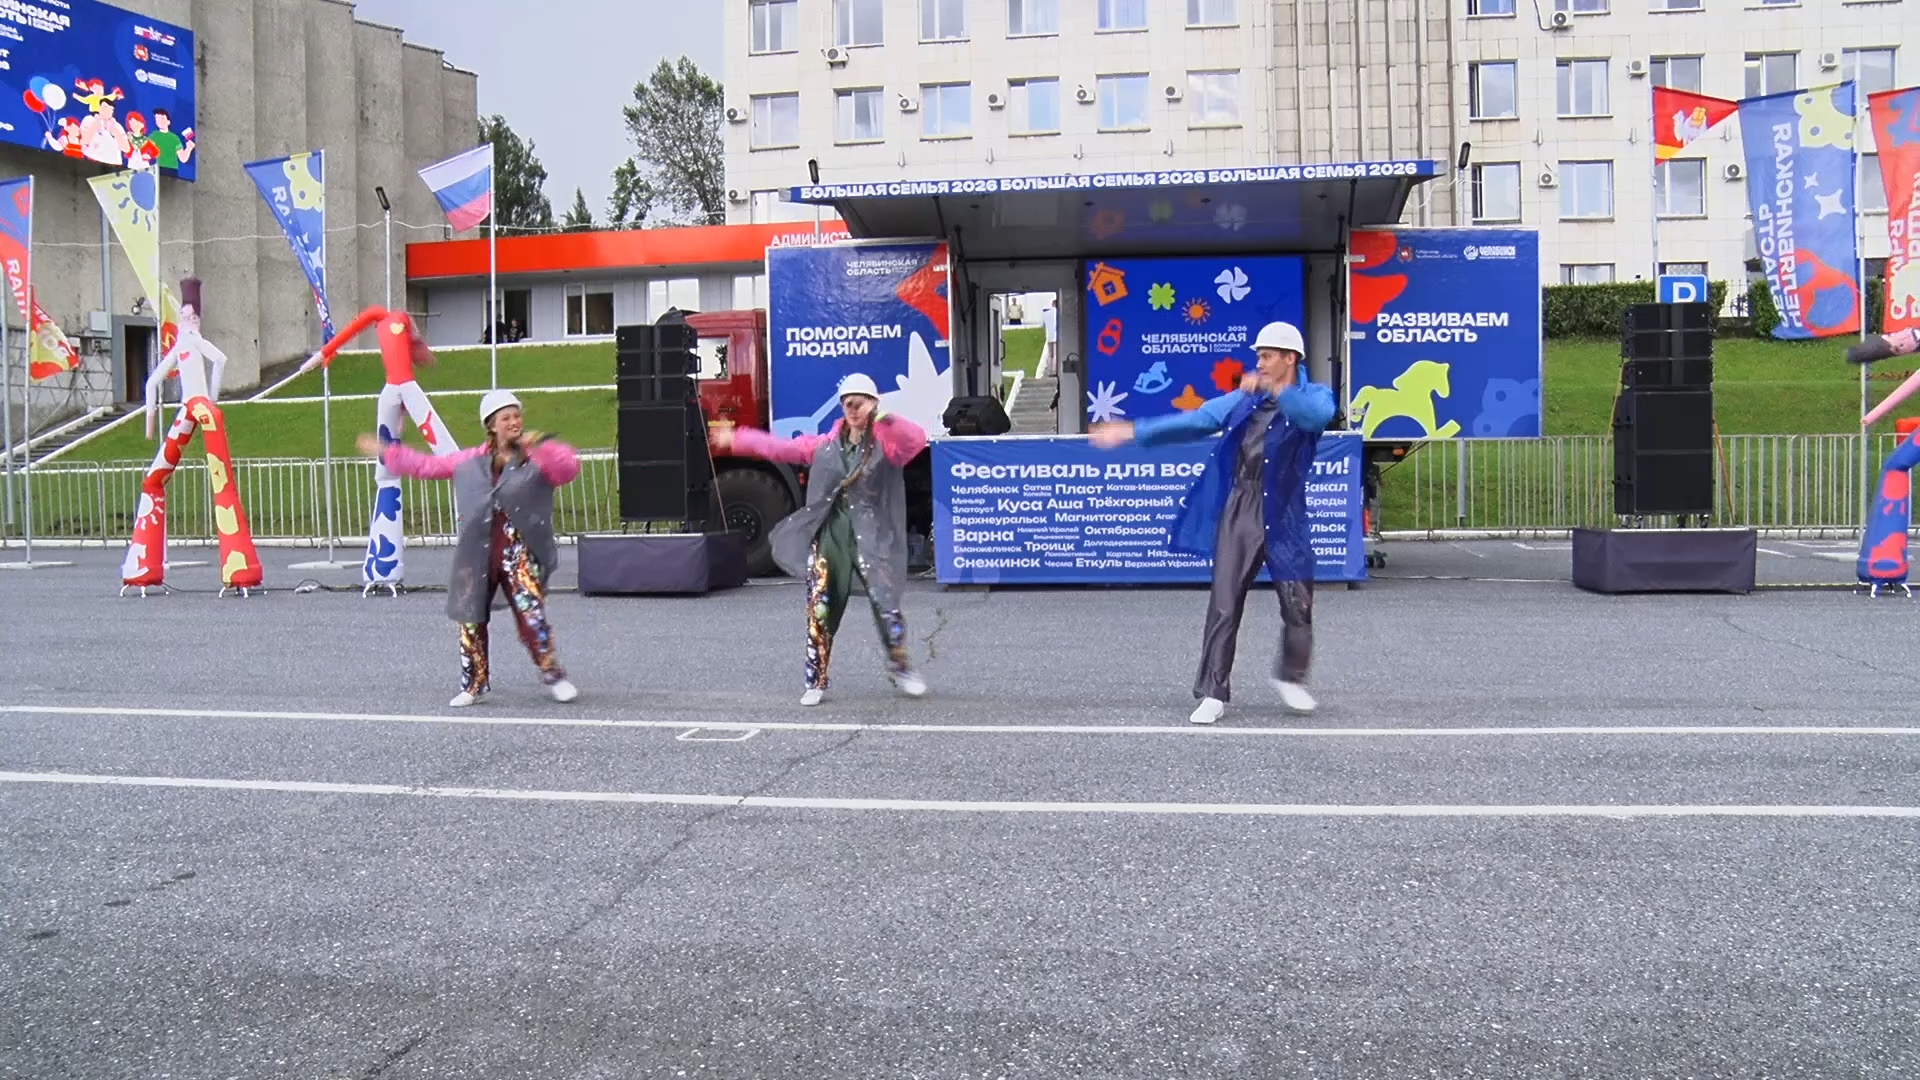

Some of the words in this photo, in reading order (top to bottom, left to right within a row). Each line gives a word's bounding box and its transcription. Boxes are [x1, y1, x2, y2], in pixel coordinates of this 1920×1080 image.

[801, 185, 889, 200] БОЛЬШАЯ
[889, 181, 949, 196] СЕМЬЯ
[952, 179, 998, 194] 2026
[1000, 176, 1090, 191] БОЛЬШАЯ
[1093, 173, 1156, 188] СЕМЬЯ
[1158, 171, 1206, 186] 2026
[1208, 168, 1301, 183] БОЛЬШАЯ
[1303, 165, 1368, 180] СЕМЬЯ
[1369, 162, 1417, 176] 2026
[846, 259, 918, 269] ЧЕЛЯБИНСКАЯ
[846, 267, 892, 276] ОБЛАСТЬ
[1376, 312, 1509, 327] РАЗВИВАЕМ
[785, 324, 902, 341] ПОМОГАЕМ
[1141, 332, 1247, 344] ЧЕЛЯБИНСКАЯ
[1376, 328, 1478, 343] ОБЛАСТЬ
[785, 341, 869, 358] ЛЮДЯМ
[1141, 343, 1208, 354] ОБЛАСТЬ
[950, 461, 1101, 480] Фестиваль
[1103, 463, 1155, 480] для
[1160, 462, 1206, 477] все
[951, 484, 1019, 495] Челябинск
[1022, 483, 1052, 491] Сатка
[1055, 483, 1104, 495] Пласт
[1106, 483, 1186, 491] Катав-Ивановск
[997, 498, 1043, 513] Куса
[1046, 498, 1083, 509] Аша
[1087, 495, 1174, 509] Трёхгорный
[1305, 496, 1347, 507] Бреды
[952, 506, 995, 514] Златоуст
[952, 515, 1047, 526] Верхнеуральск
[1054, 512, 1151, 523] Магнитогорск
[953, 528, 1015, 544] Варна
[1084, 525, 1167, 536] Октябрьское
[1023, 541, 1076, 553] Троицк
[1083, 539, 1163, 548] Долгодеревенское
[953, 545, 1022, 554] Еманжелинск
[953, 556, 1041, 568] Снежинск
[1075, 557, 1123, 569] Еткуль
[1124, 560, 1166, 568] Верхний
[1167, 559, 1207, 568] Уфалей
